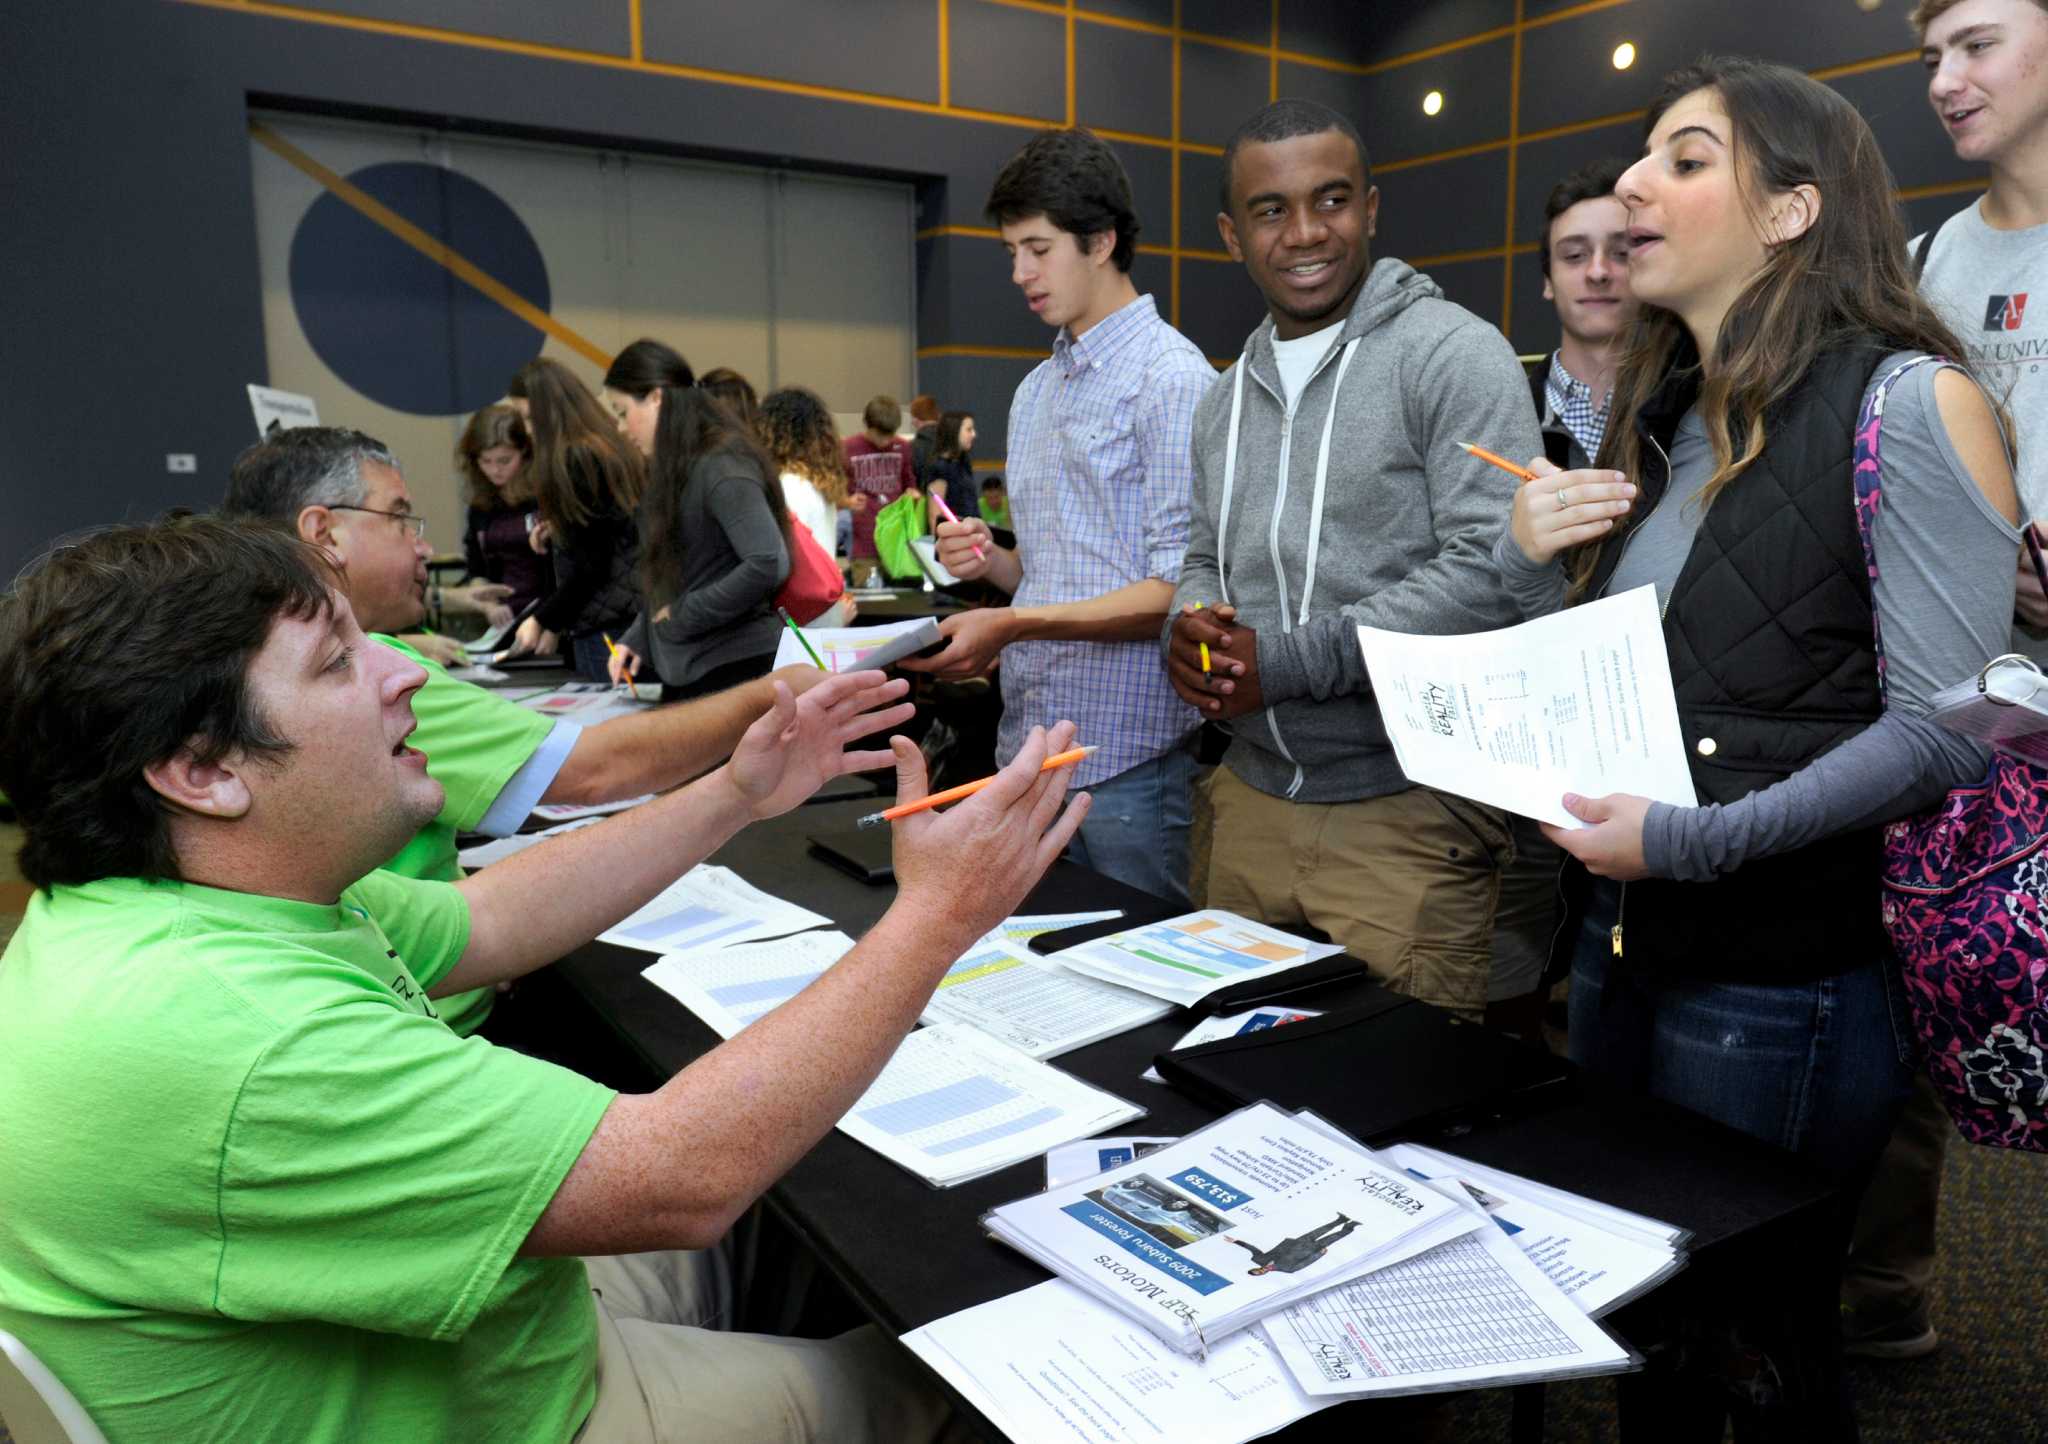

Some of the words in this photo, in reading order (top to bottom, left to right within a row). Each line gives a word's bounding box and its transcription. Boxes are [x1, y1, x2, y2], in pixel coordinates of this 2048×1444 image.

[1996, 338, 2048, 361] UNIV
[1427, 682, 1453, 735] REALITY
[1208, 1152, 1247, 1175] transmission
[1277, 1162, 1306, 1179] Standard
[1281, 1156, 1315, 1175] Navigation
[1184, 1171, 1237, 1205] $13,759
[1247, 1173, 1280, 1192] Automatic
[1353, 1172, 1424, 1210] REALITY
[1241, 1205, 1264, 1220] Just
[1360, 1186, 1416, 1216] Financial
[1088, 1211, 1134, 1240] Forester
[1130, 1235, 1172, 1264] Subaru
[1092, 1252, 1165, 1300] Motors
[1168, 1259, 1201, 1281] 2009
[1317, 1343, 1351, 1379] REALITY
